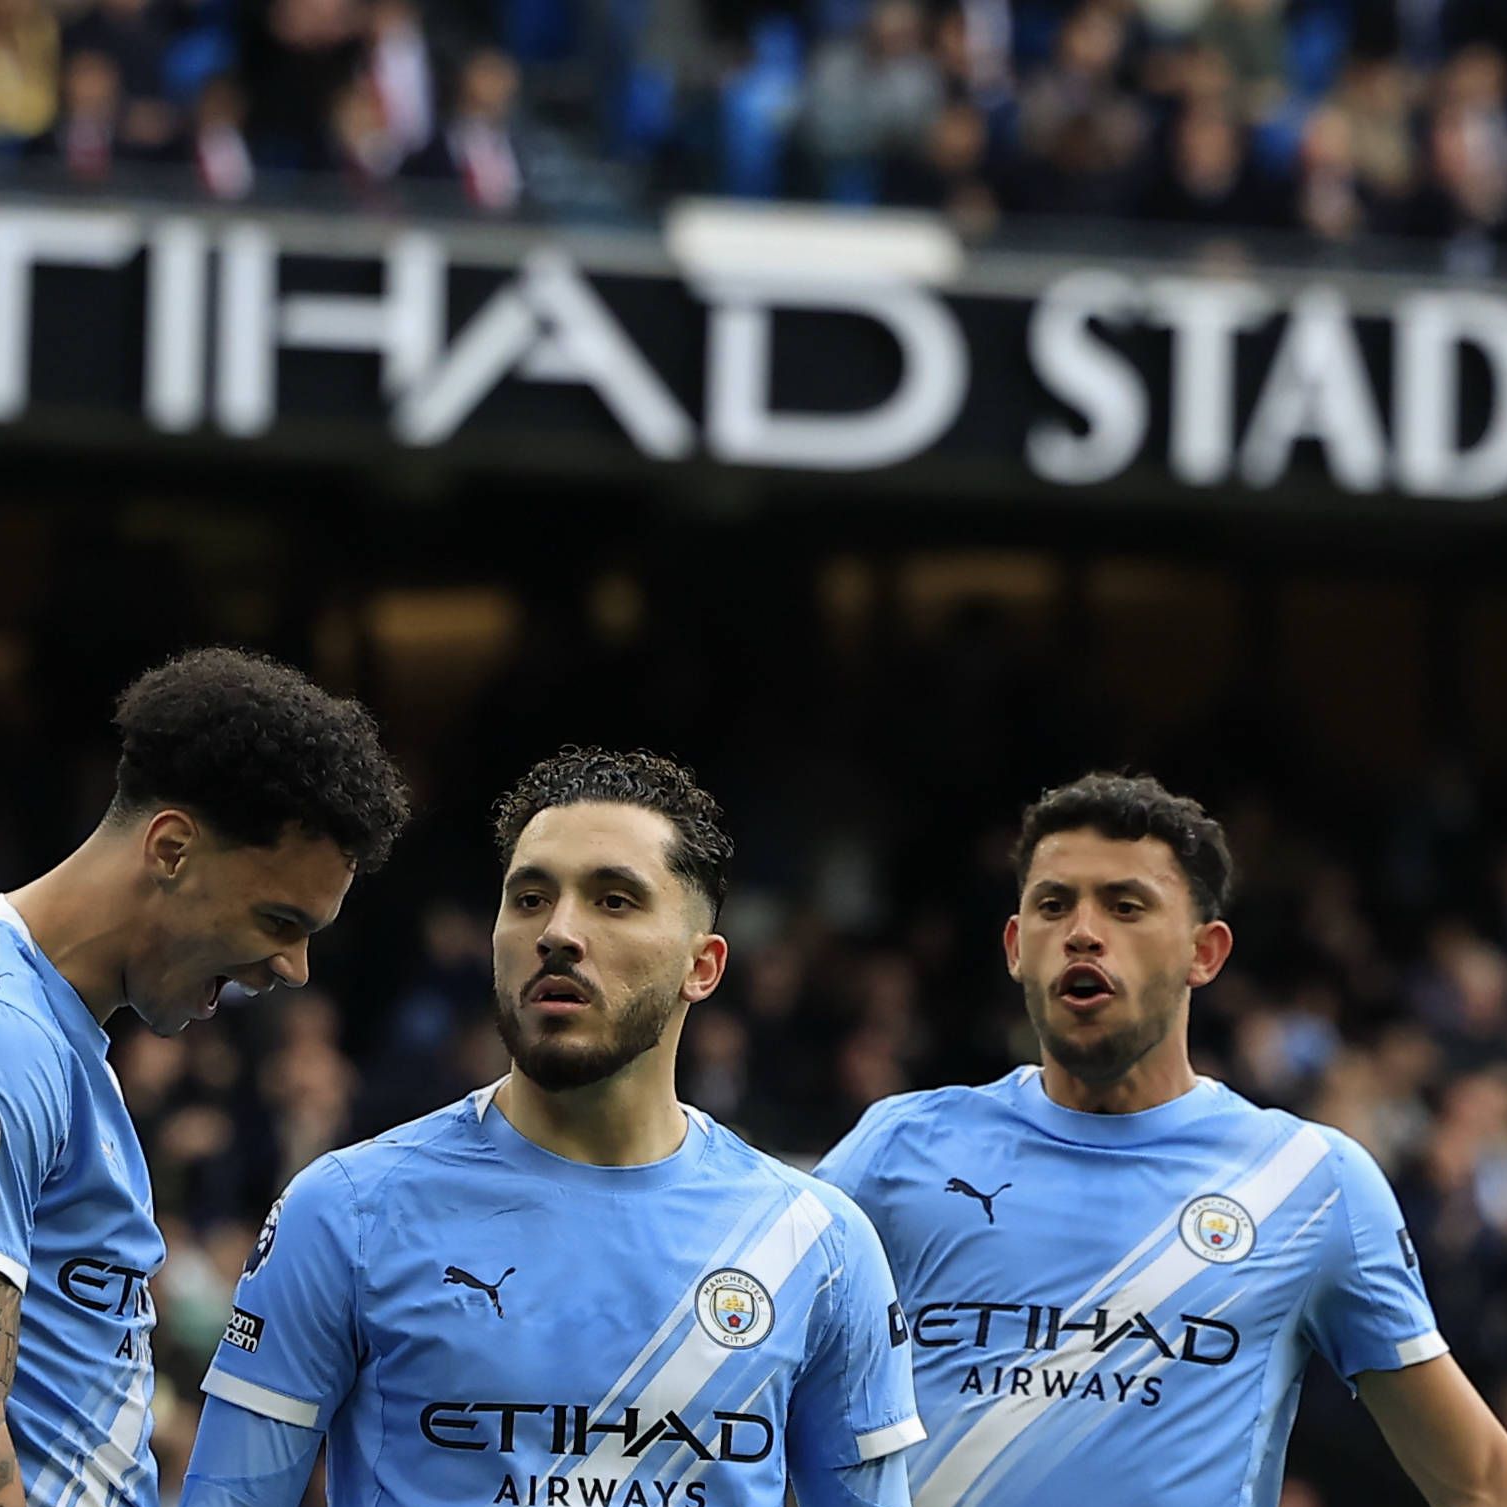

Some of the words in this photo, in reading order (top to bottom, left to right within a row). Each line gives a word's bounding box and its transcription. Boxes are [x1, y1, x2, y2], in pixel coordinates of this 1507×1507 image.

[704, 1275, 764, 1303] MANCHESTER
[723, 1335, 746, 1344] CITY
[913, 1302, 1240, 1365] ETIHAD
[959, 1366, 1163, 1407] AIRWAYS
[419, 1402, 775, 1463] ETIHAD
